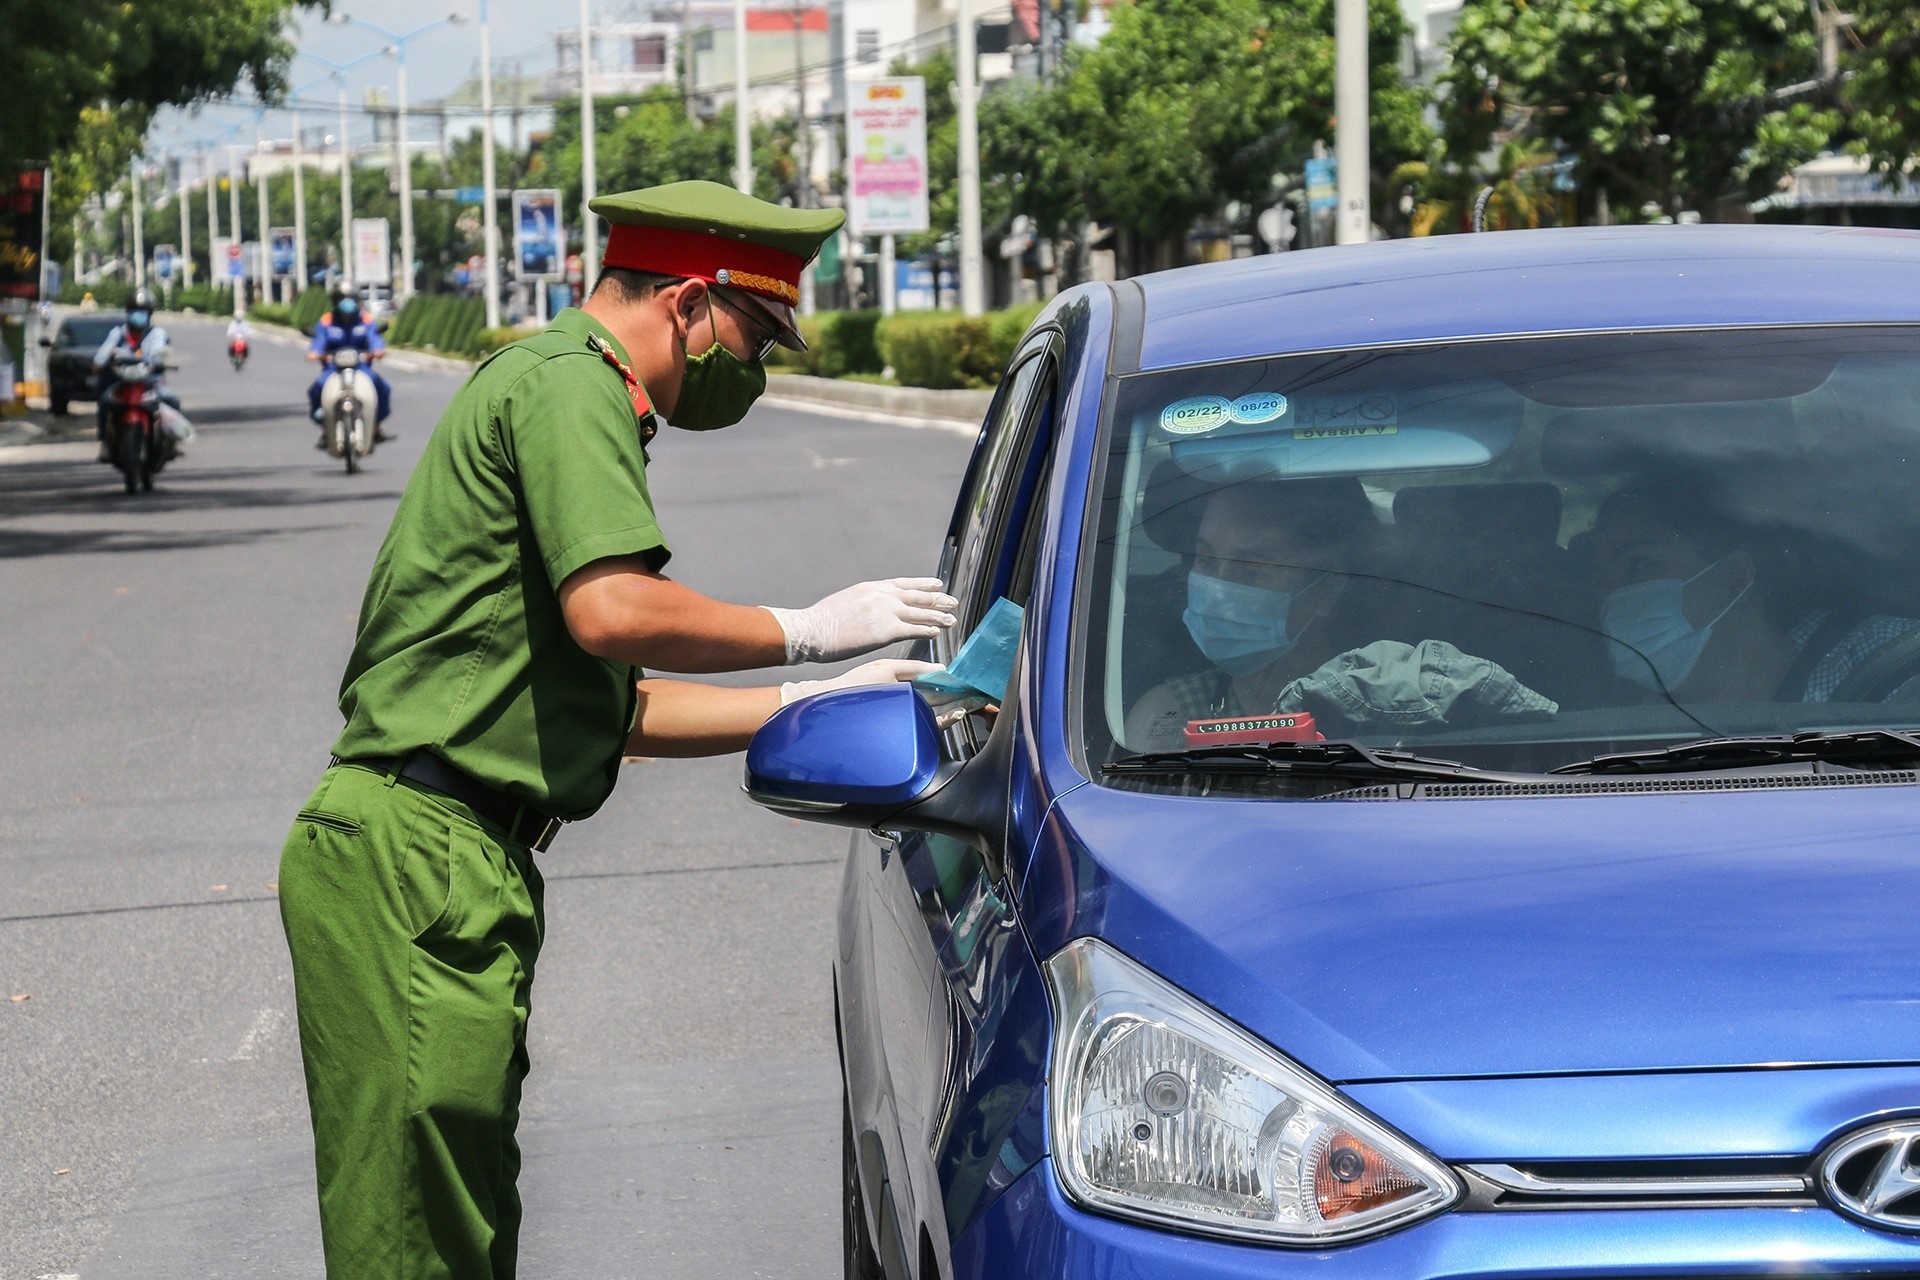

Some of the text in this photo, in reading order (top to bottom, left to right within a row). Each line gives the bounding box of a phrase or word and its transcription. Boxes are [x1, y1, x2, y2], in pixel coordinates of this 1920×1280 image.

[1177, 405, 1221, 419] 02/22
[1241, 400, 1278, 412] 08/20
[1303, 427, 1367, 438] AIRBAG
